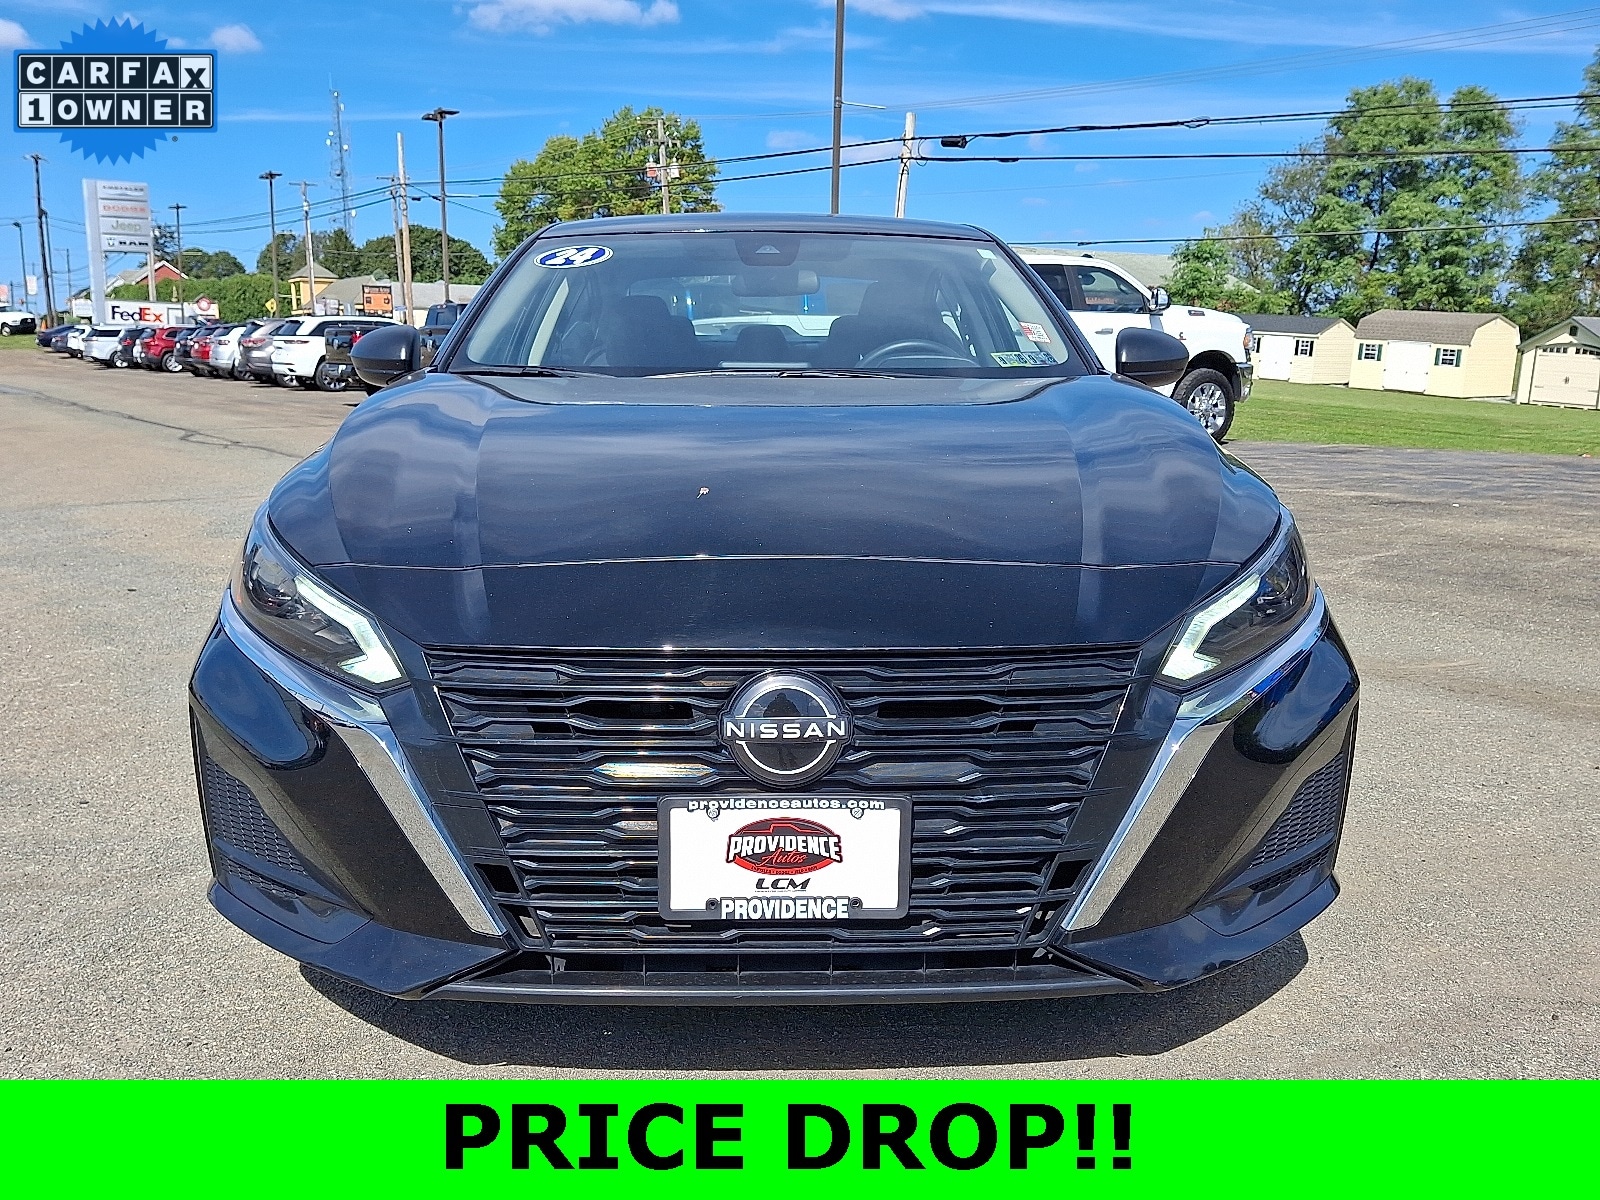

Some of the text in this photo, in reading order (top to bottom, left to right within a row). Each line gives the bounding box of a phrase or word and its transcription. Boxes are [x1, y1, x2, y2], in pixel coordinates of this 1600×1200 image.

[111, 220, 142, 232] Jeep
[544, 247, 601, 266] 24
[111, 305, 164, 323] FedEx
[726, 720, 846, 739] NISSAN
[687, 798, 886, 811] providenceautos.com
[727, 835, 842, 863] PROVIDENCE
[755, 847, 808, 867] Autos
[756, 878, 811, 890] LCM
[720, 896, 850, 920] PROVIDENCE
